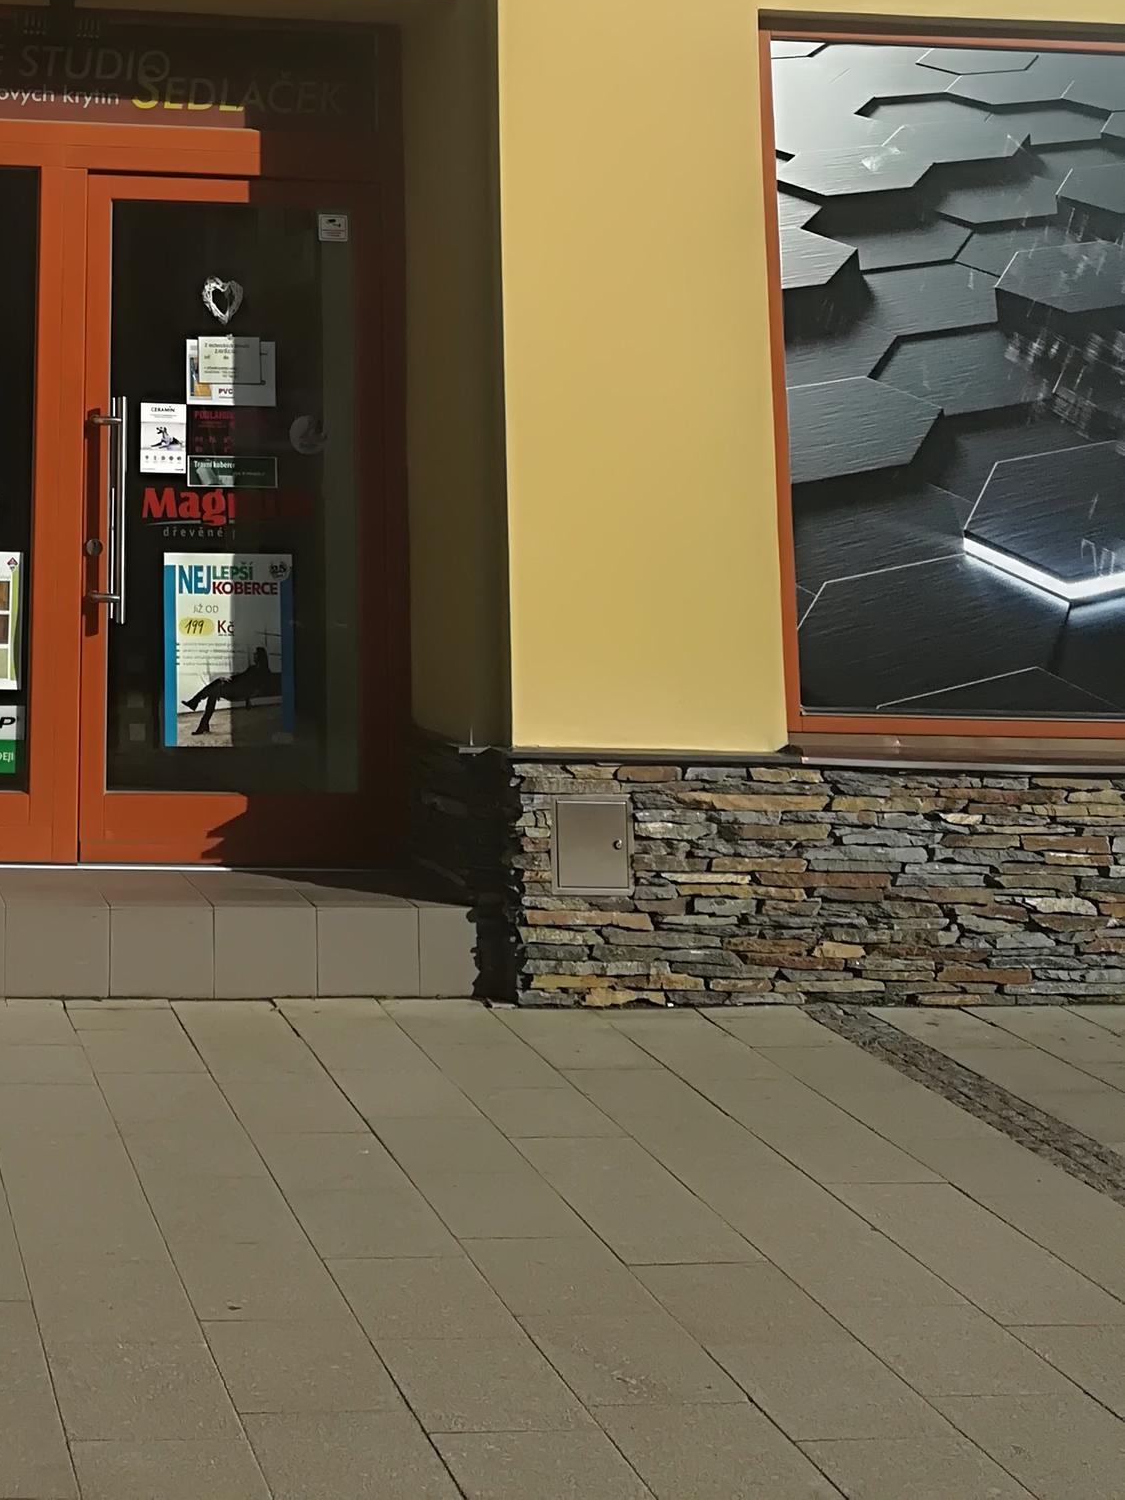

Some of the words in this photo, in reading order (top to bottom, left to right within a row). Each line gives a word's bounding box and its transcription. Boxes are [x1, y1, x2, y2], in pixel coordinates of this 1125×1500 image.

[19, 45, 171, 83] STUDIO
[63, 85, 120, 109] krytin
[163, 526, 224, 538] dřevěné
[178, 564, 211, 595] NEJ
[212, 561, 254, 581] LEPŠÍ
[212, 581, 279, 596] KOBERCE
[205, 604, 220, 614] OD
[184, 618, 205, 635] 199
[217, 619, 236, 635] Kč
